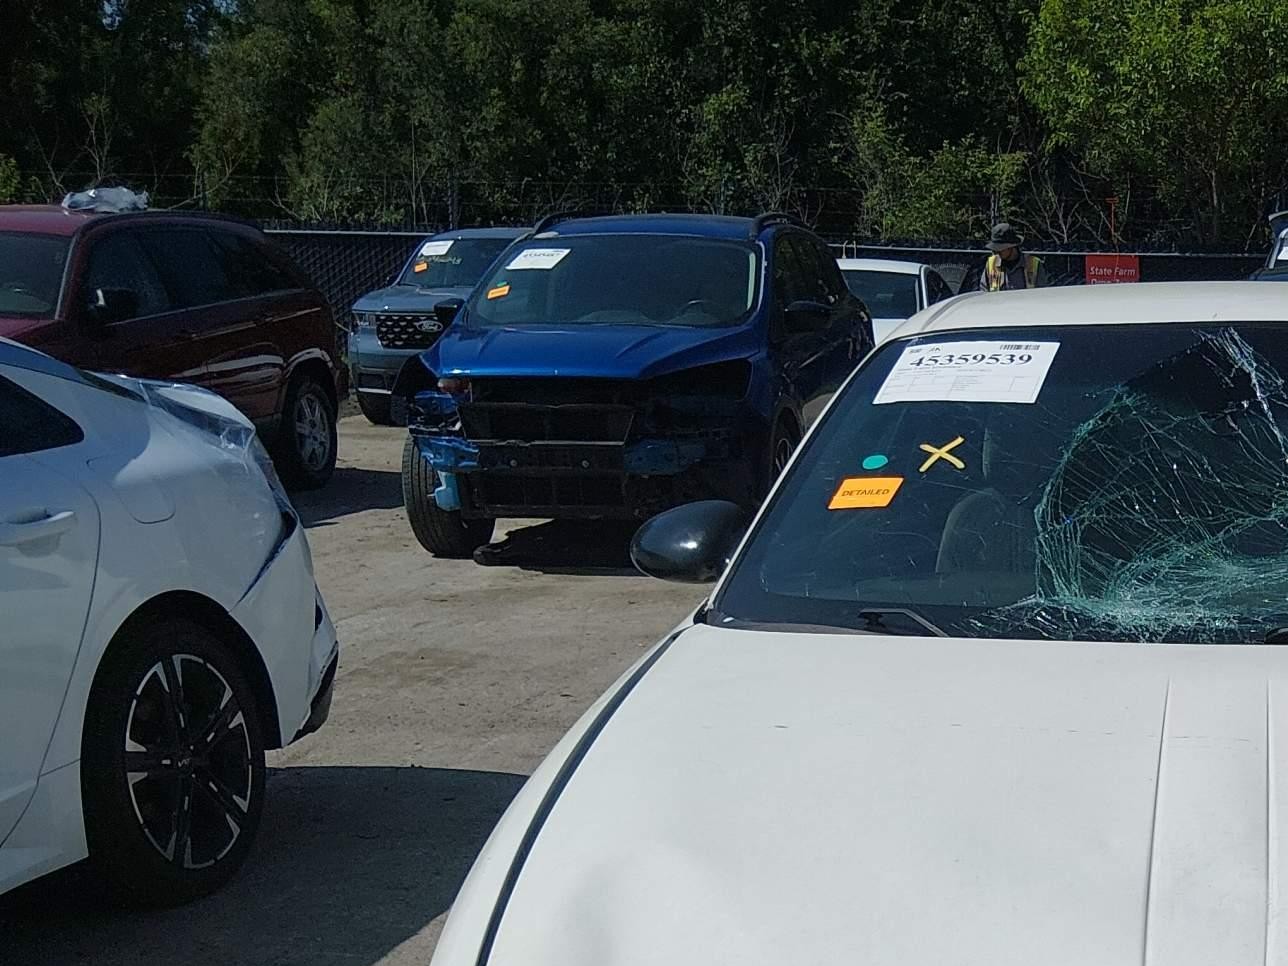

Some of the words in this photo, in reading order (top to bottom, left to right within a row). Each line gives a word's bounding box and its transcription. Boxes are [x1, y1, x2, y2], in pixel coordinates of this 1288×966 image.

[1090, 266, 1112, 276] State
[1114, 267, 1136, 276] Farm
[419, 321, 441, 333] Ford
[910, 353, 1033, 367] 45359539
[841, 488, 890, 497] DETAILED
